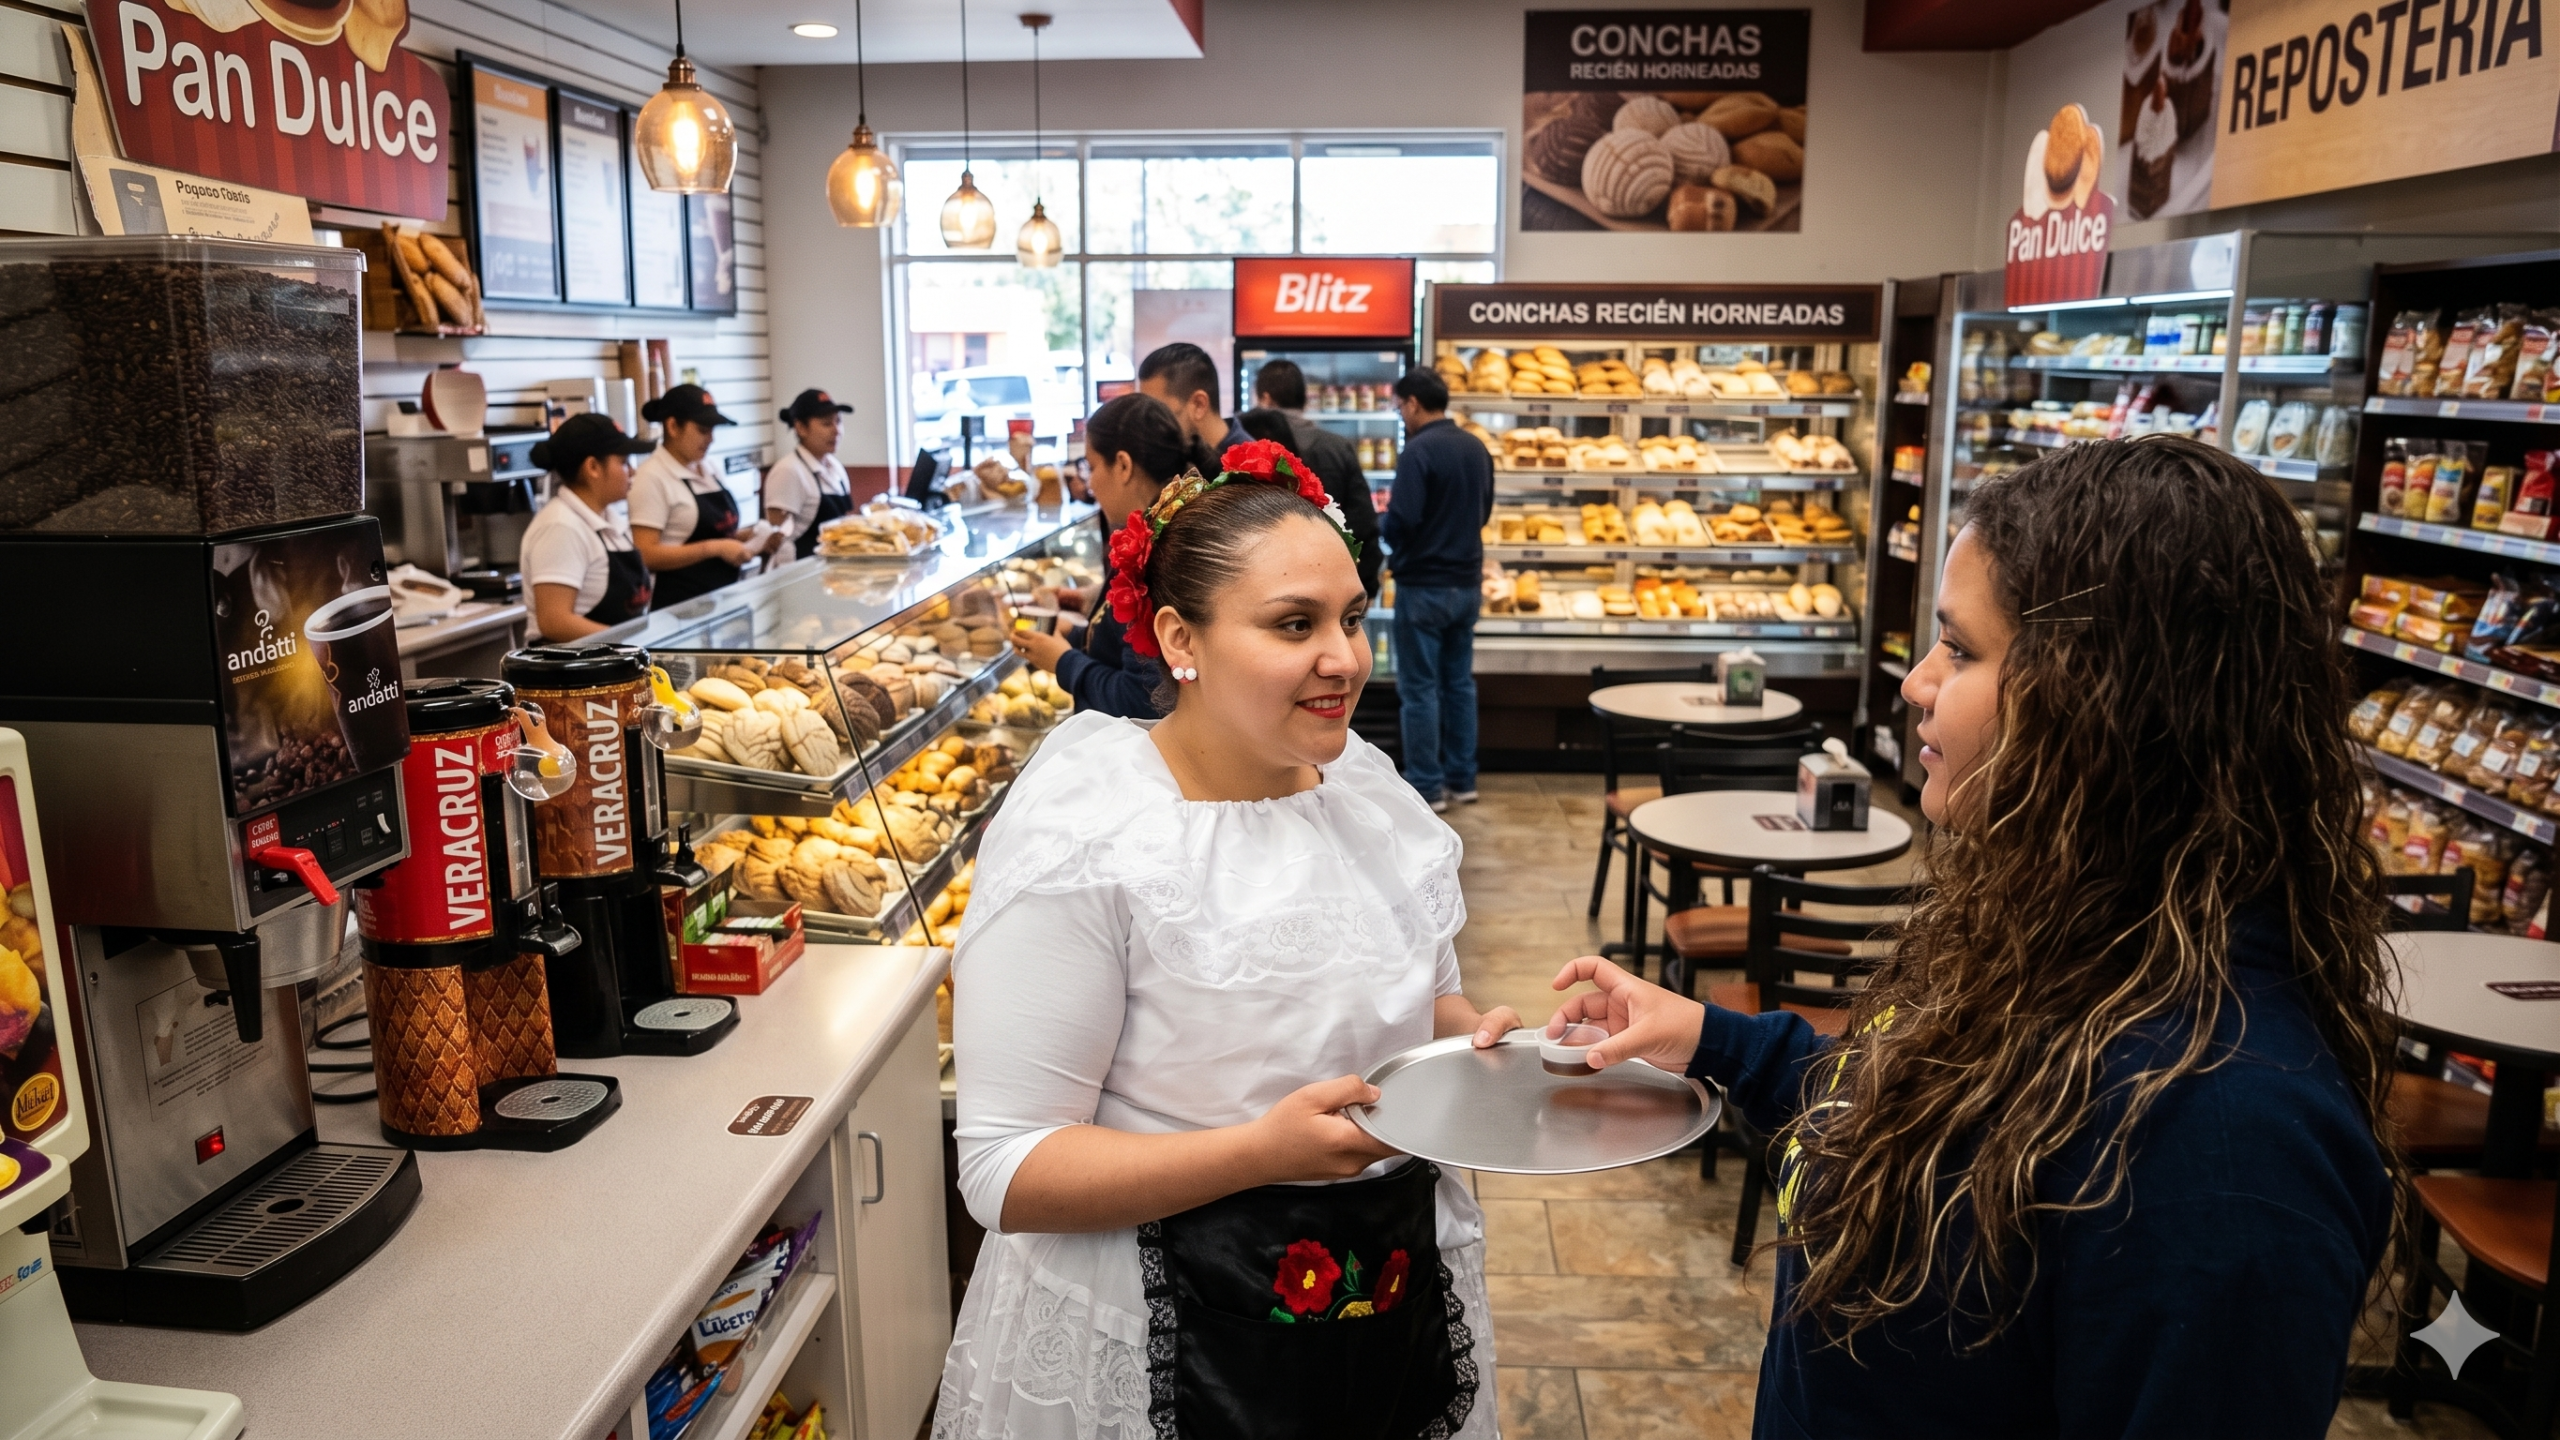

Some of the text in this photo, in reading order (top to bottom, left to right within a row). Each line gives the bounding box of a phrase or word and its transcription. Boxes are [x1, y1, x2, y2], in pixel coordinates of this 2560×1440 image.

[1570, 24, 1762, 56] CONCHAS
[118, 0, 438, 164] Pan Dulce
[1569, 60, 1761, 79] RECIÉN HORNEADAS
[2007, 209, 2107, 263] Pan Dulce
[1273, 272, 1373, 313] Blitz
[1469, 297, 1845, 326] CONCHAS RECIÉN HORNEADAS
[227, 631, 297, 671] andatti
[348, 680, 399, 713] andatti
[586, 699, 627, 865] VERACRUZ
[434, 745, 486, 930] VERACRUZ
